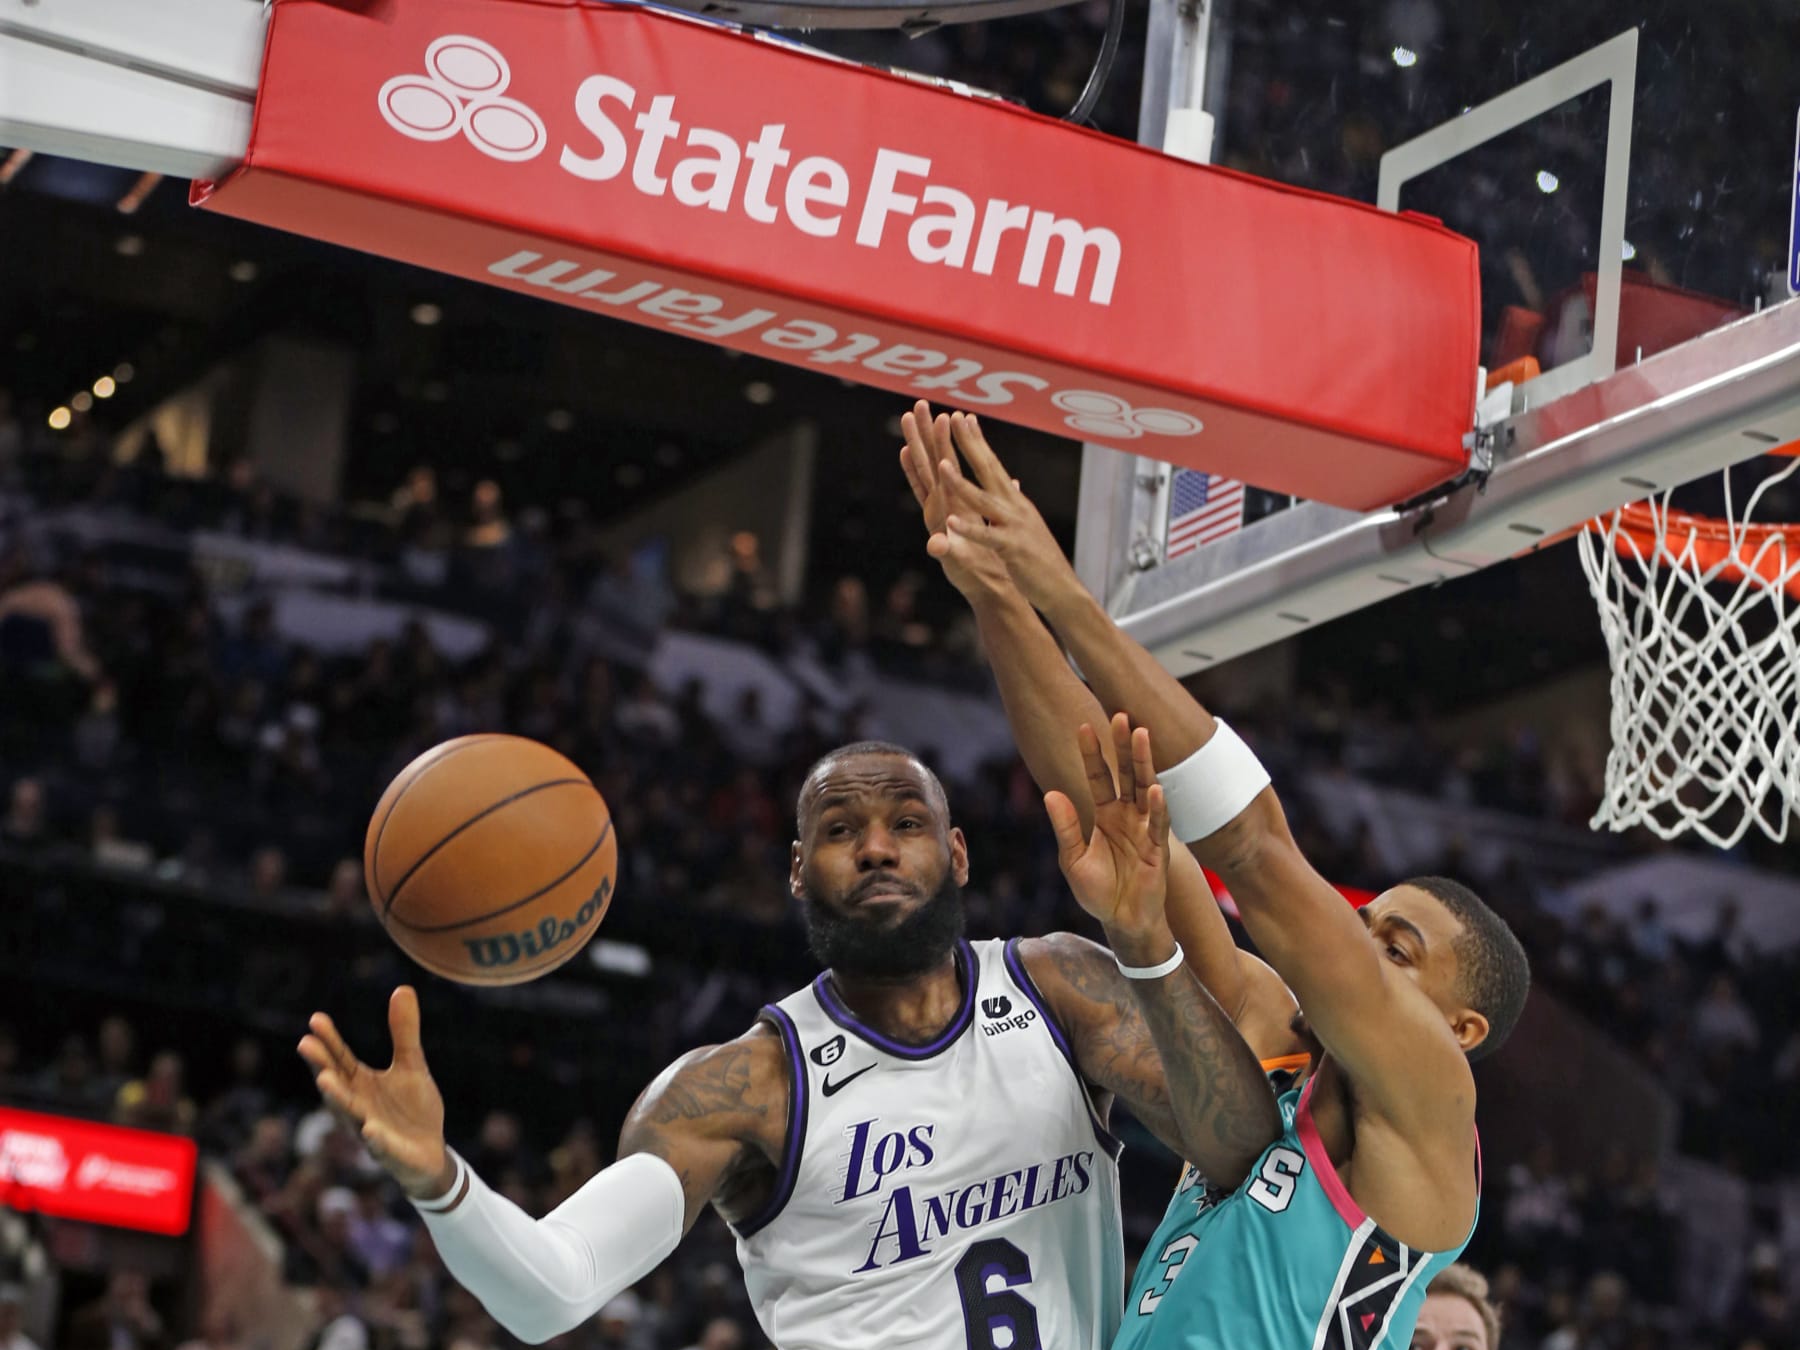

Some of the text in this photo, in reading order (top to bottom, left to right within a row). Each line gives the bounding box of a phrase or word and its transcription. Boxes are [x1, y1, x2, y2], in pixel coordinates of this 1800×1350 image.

[463, 875, 612, 968] Wilson
[981, 1009, 1036, 1037] bibigo
[820, 1040, 840, 1065] 6
